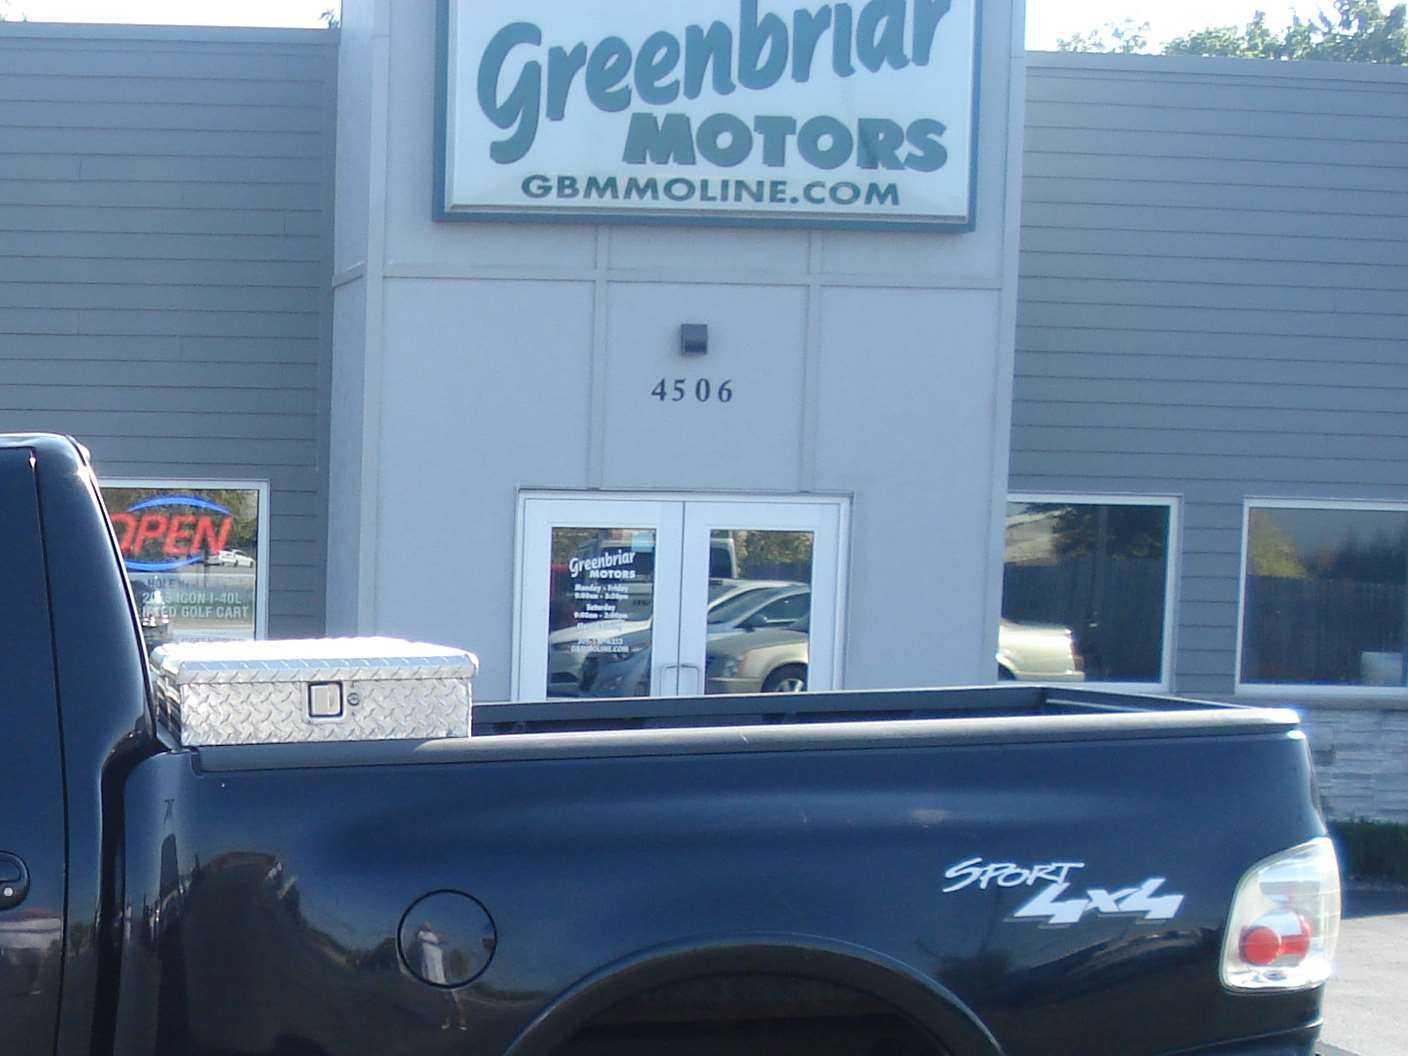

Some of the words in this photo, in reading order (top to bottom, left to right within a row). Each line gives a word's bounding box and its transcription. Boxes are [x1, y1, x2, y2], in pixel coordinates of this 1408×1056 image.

[477, 0, 951, 164] Greenbriar
[621, 112, 949, 173] MOTORS
[520, 174, 901, 207] GBMMOLINE.COM
[650, 377, 734, 403] 4506
[569, 550, 636, 577] Greenbriar
[589, 570, 636, 579] MOTORS
[181, 606, 213, 618] GOLF
[216, 606, 249, 618] CART
[942, 858, 1085, 893] SPORT
[1003, 878, 1184, 928] 4x4
